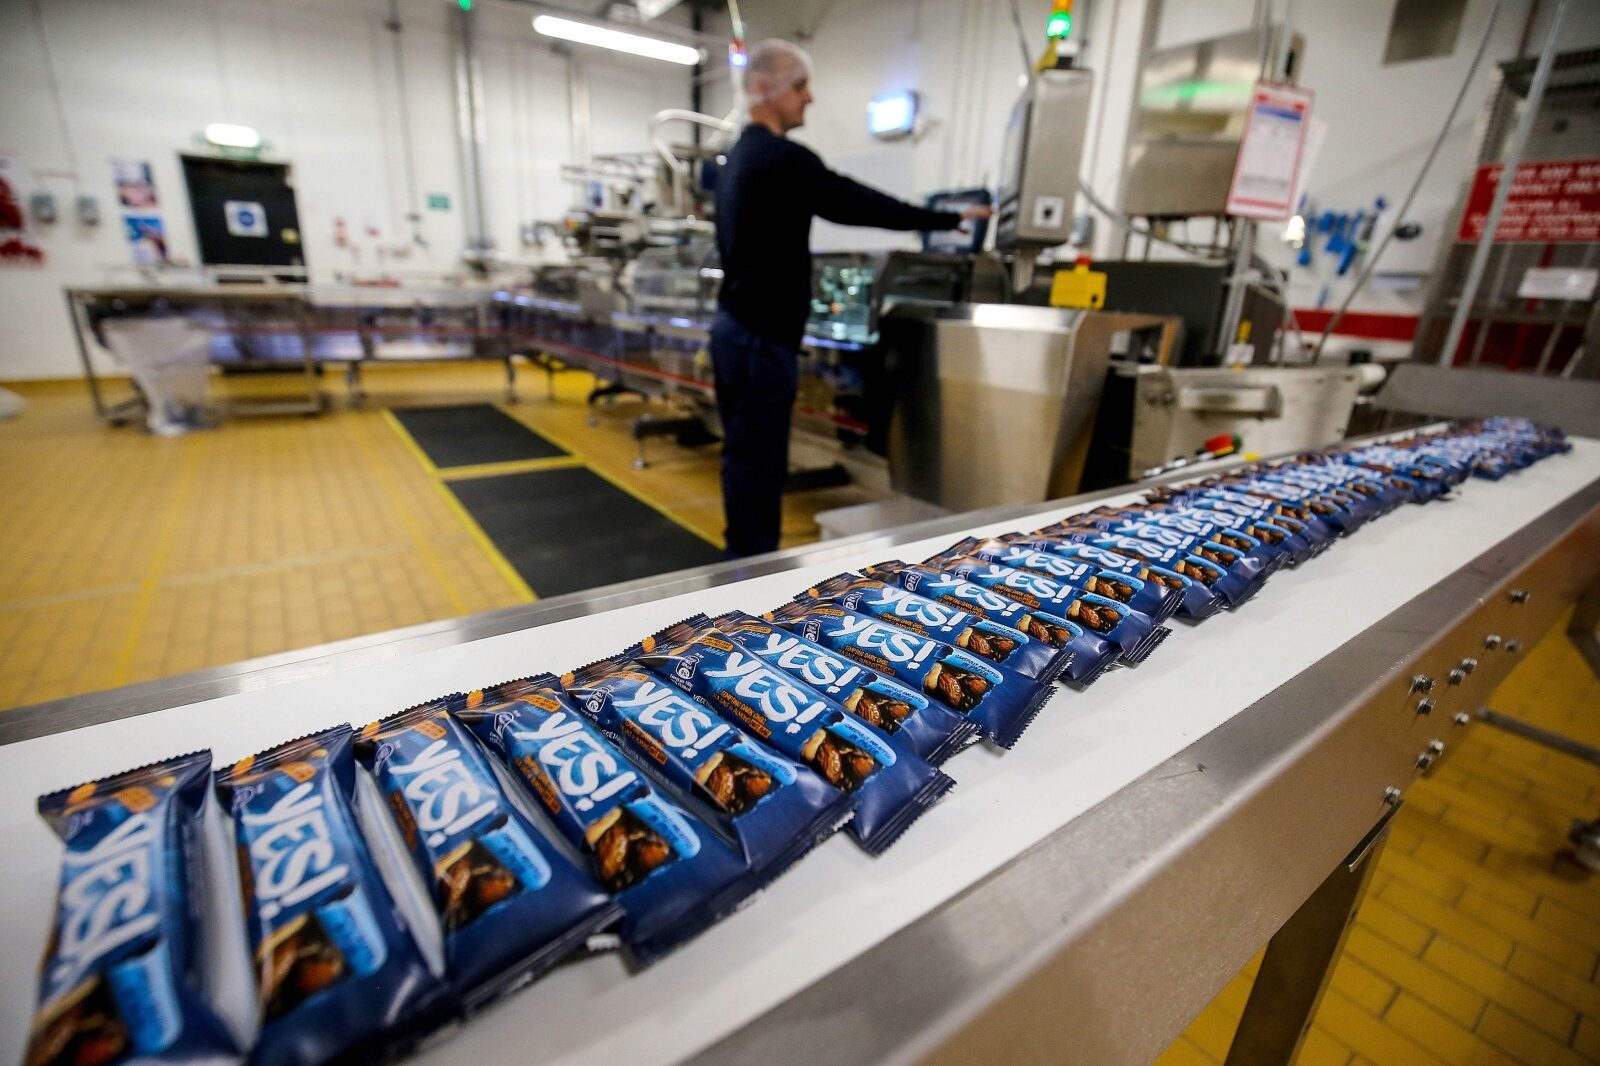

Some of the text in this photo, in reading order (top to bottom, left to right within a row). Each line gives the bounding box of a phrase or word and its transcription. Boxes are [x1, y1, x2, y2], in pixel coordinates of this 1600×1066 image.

[1093, 532, 1177, 562] YES!
[1115, 519, 1195, 549] YES!
[1136, 511, 1214, 536] YES!
[1001, 547, 1089, 580] YES!
[1054, 541, 1140, 573] YES!
[927, 573, 1025, 617] YES!
[978, 564, 1073, 604] YES!
[866, 587, 968, 631] YES!
[753, 633, 862, 694] YES!
[827, 615, 937, 670] YES!
[703, 652, 827, 734] YES!
[612, 682, 732, 758] YES!
[512, 712, 637, 811] YES!
[388, 740, 498, 848] YES!
[242, 782, 349, 919] YES!
[51, 812, 160, 982] YES!
